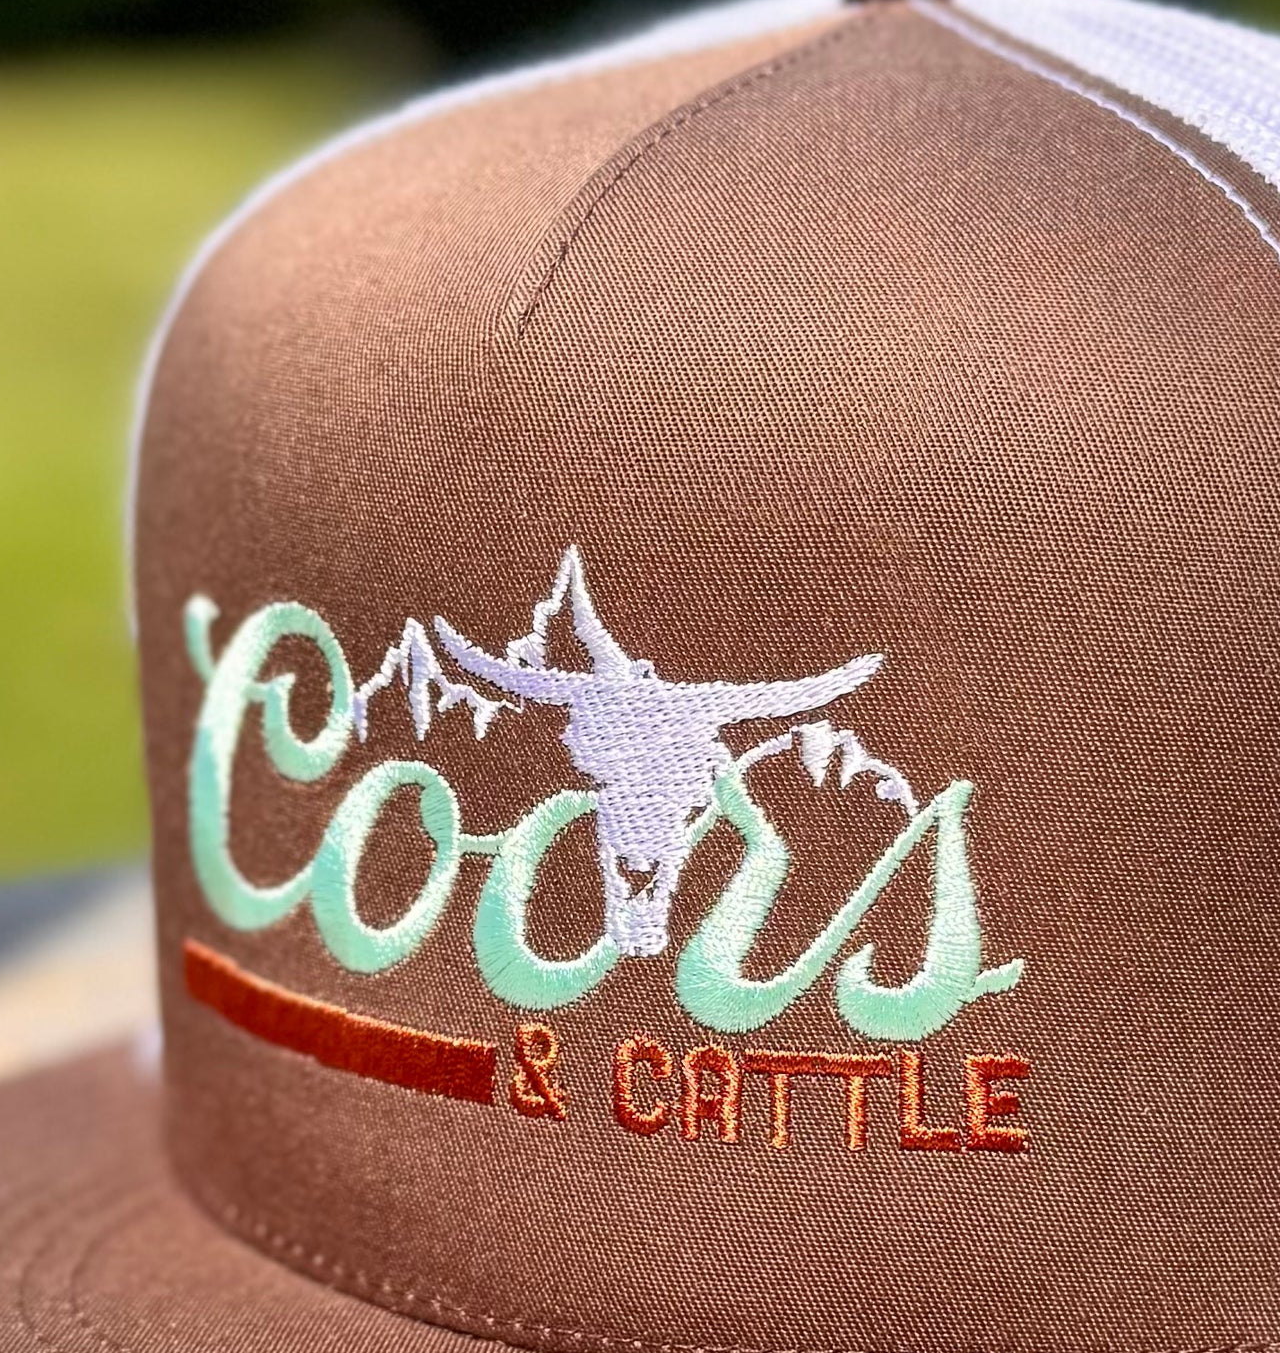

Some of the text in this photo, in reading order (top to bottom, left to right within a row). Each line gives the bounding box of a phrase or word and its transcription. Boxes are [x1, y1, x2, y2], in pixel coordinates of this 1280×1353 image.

[184, 593, 1025, 1041] Coors
[509, 1022, 1030, 1153] & CATTLE
